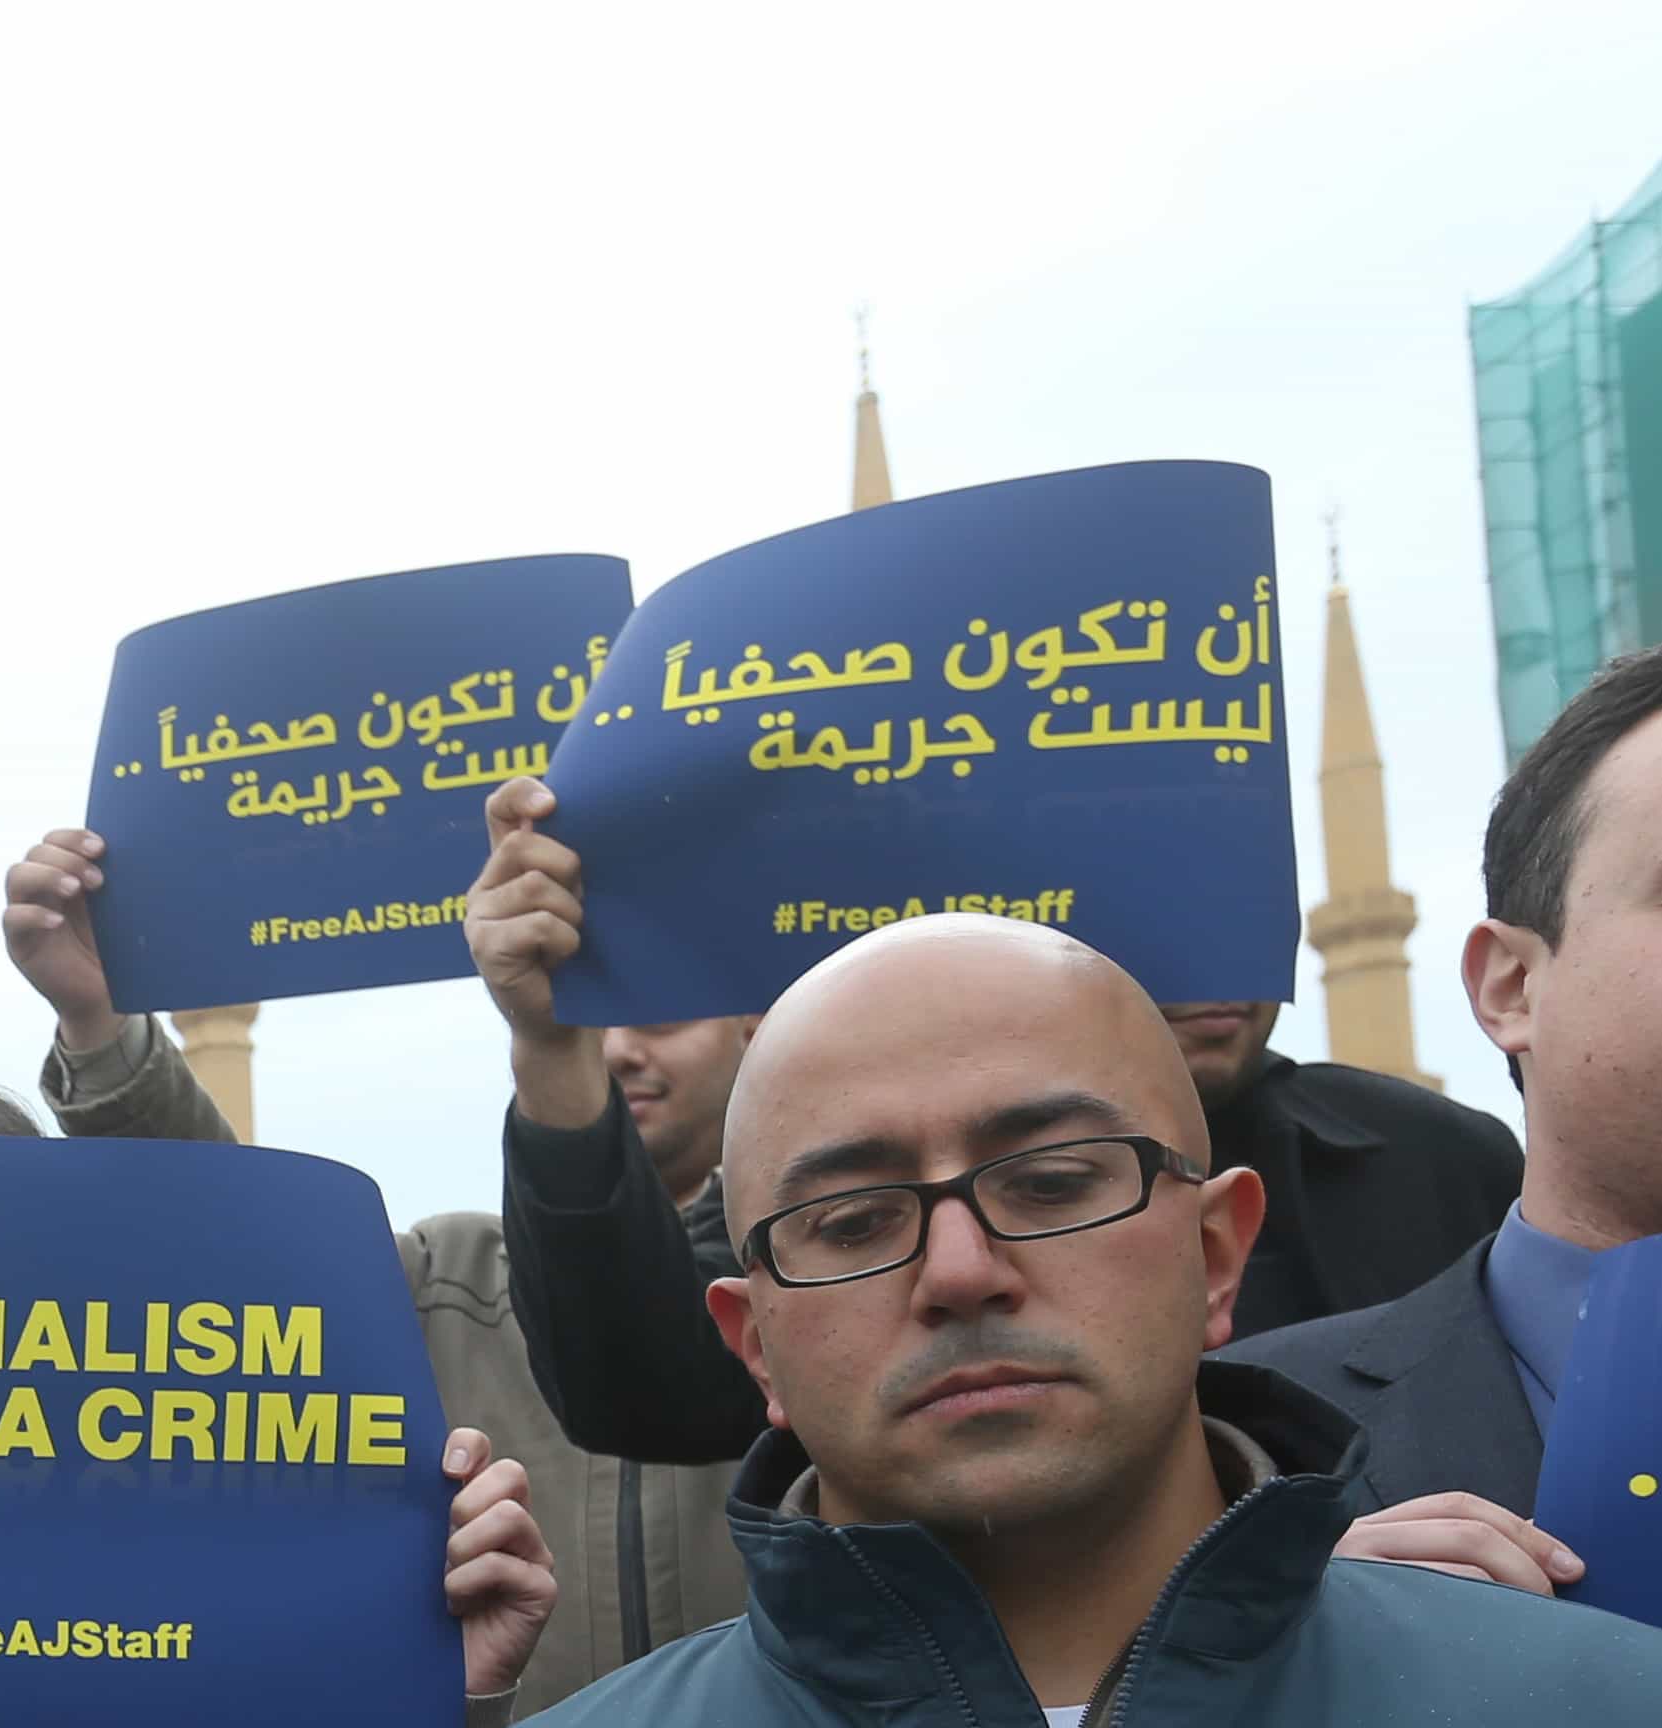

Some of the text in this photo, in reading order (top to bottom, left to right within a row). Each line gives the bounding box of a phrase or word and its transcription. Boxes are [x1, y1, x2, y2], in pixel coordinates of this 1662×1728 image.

[945, 600, 1167, 690] تكون
[1197, 577, 1269, 675] أن
[359, 671, 514, 754] تكون
[751, 684, 1272, 784] ليست جريمة
[229, 767, 401, 823] جريمة
[79, 1388, 406, 1465] CRIME
